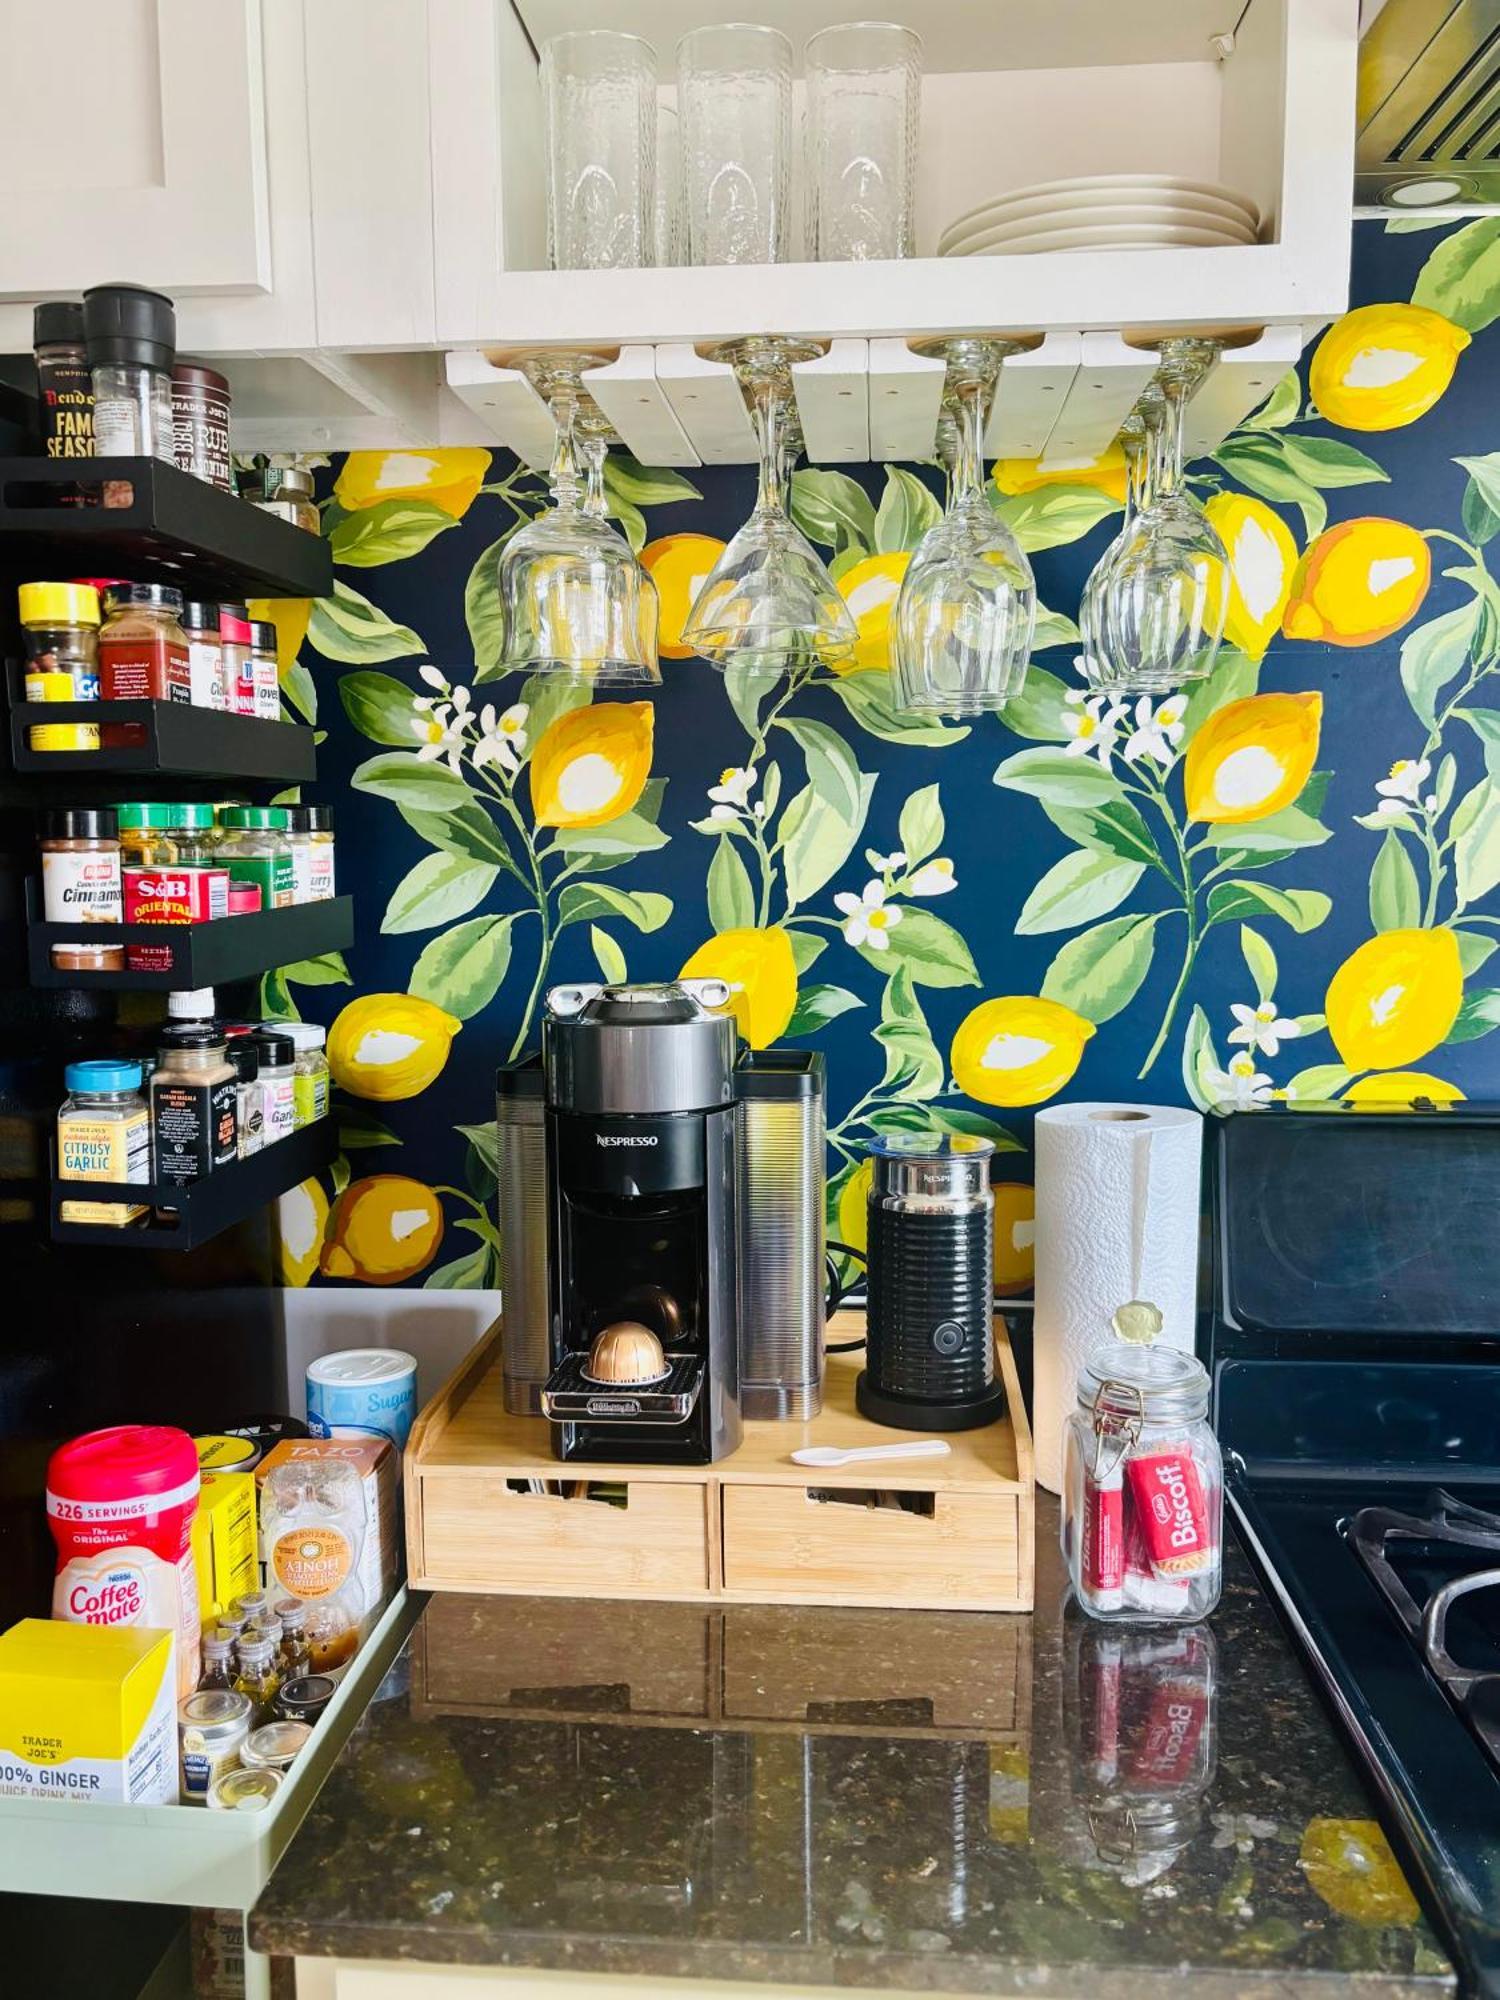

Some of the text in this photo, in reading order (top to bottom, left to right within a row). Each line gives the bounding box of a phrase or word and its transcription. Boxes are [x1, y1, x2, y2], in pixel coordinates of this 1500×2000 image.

[56, 412, 96, 436] FAM
[194, 424, 229, 452] RUB
[137, 880, 187, 897] S&B
[134, 901, 194, 918] ORIENTAL
[596, 1133, 659, 1147] NESPRESSO
[63, 1142, 111, 1156] CITRUSY
[65, 1155, 110, 1172] GARLIC
[367, 1388, 414, 1413] Sugar
[290, 1447, 366, 1458] TAZO
[56, 1502, 84, 1520] 226
[1156, 1462, 1198, 1549] Biscoff
[72, 1533, 129, 1544] ORIGINAL
[91, 1527, 109, 1536] The
[69, 1581, 139, 1616] Coffee
[86, 1597, 141, 1625] mate
[22, 1735, 62, 1749] TRADER
[27, 1748, 56, 1760] JOE'S
[39, 1769, 100, 1790] GINGER
